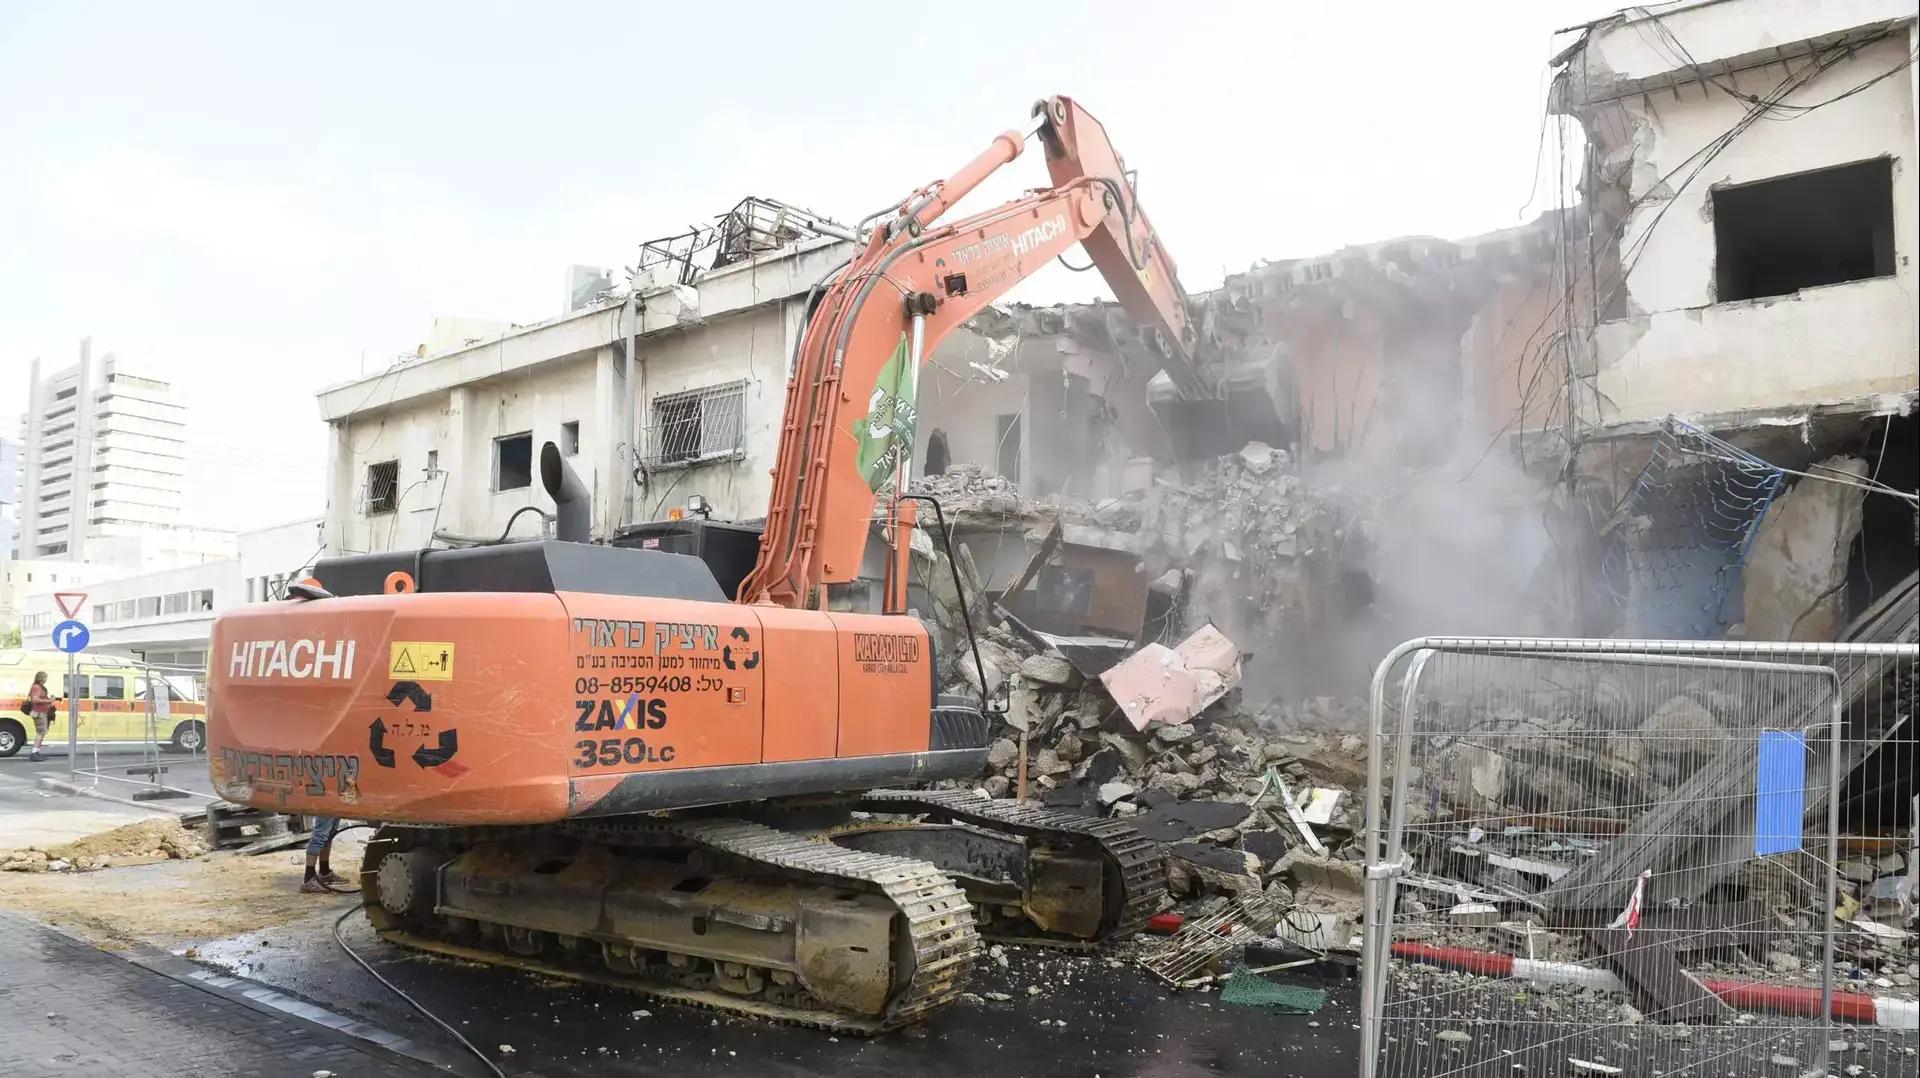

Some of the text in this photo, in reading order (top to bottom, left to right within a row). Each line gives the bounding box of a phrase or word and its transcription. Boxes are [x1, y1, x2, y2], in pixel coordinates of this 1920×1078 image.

[1011, 214, 1066, 257] HITACHI
[573, 618, 719, 656] איציק כראדי
[854, 634, 919, 663] KARADI LTD
[229, 639, 356, 680] HITACHI
[611, 656, 653, 669] הסביבה
[658, 655, 684, 672] למען
[690, 657, 721, 670] מיחזור
[575, 675, 724, 694] טל: 08-8559408
[574, 693, 667, 731] ZAXIS
